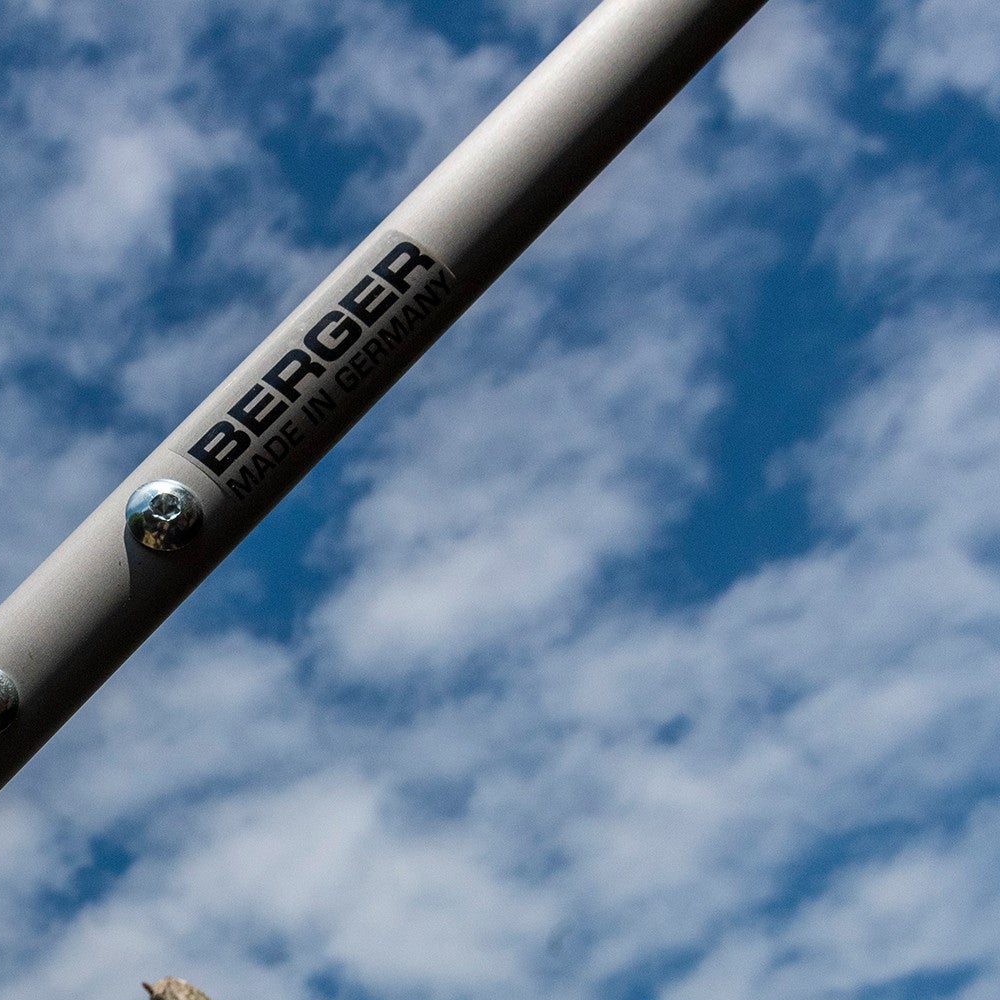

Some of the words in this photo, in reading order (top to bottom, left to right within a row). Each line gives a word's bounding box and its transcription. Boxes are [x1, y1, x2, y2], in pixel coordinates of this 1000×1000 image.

[187, 241, 436, 477] BERGER
[226, 419, 305, 500] MADE
[301, 387, 336, 427] IN
[334, 269, 457, 393] GERMANY
